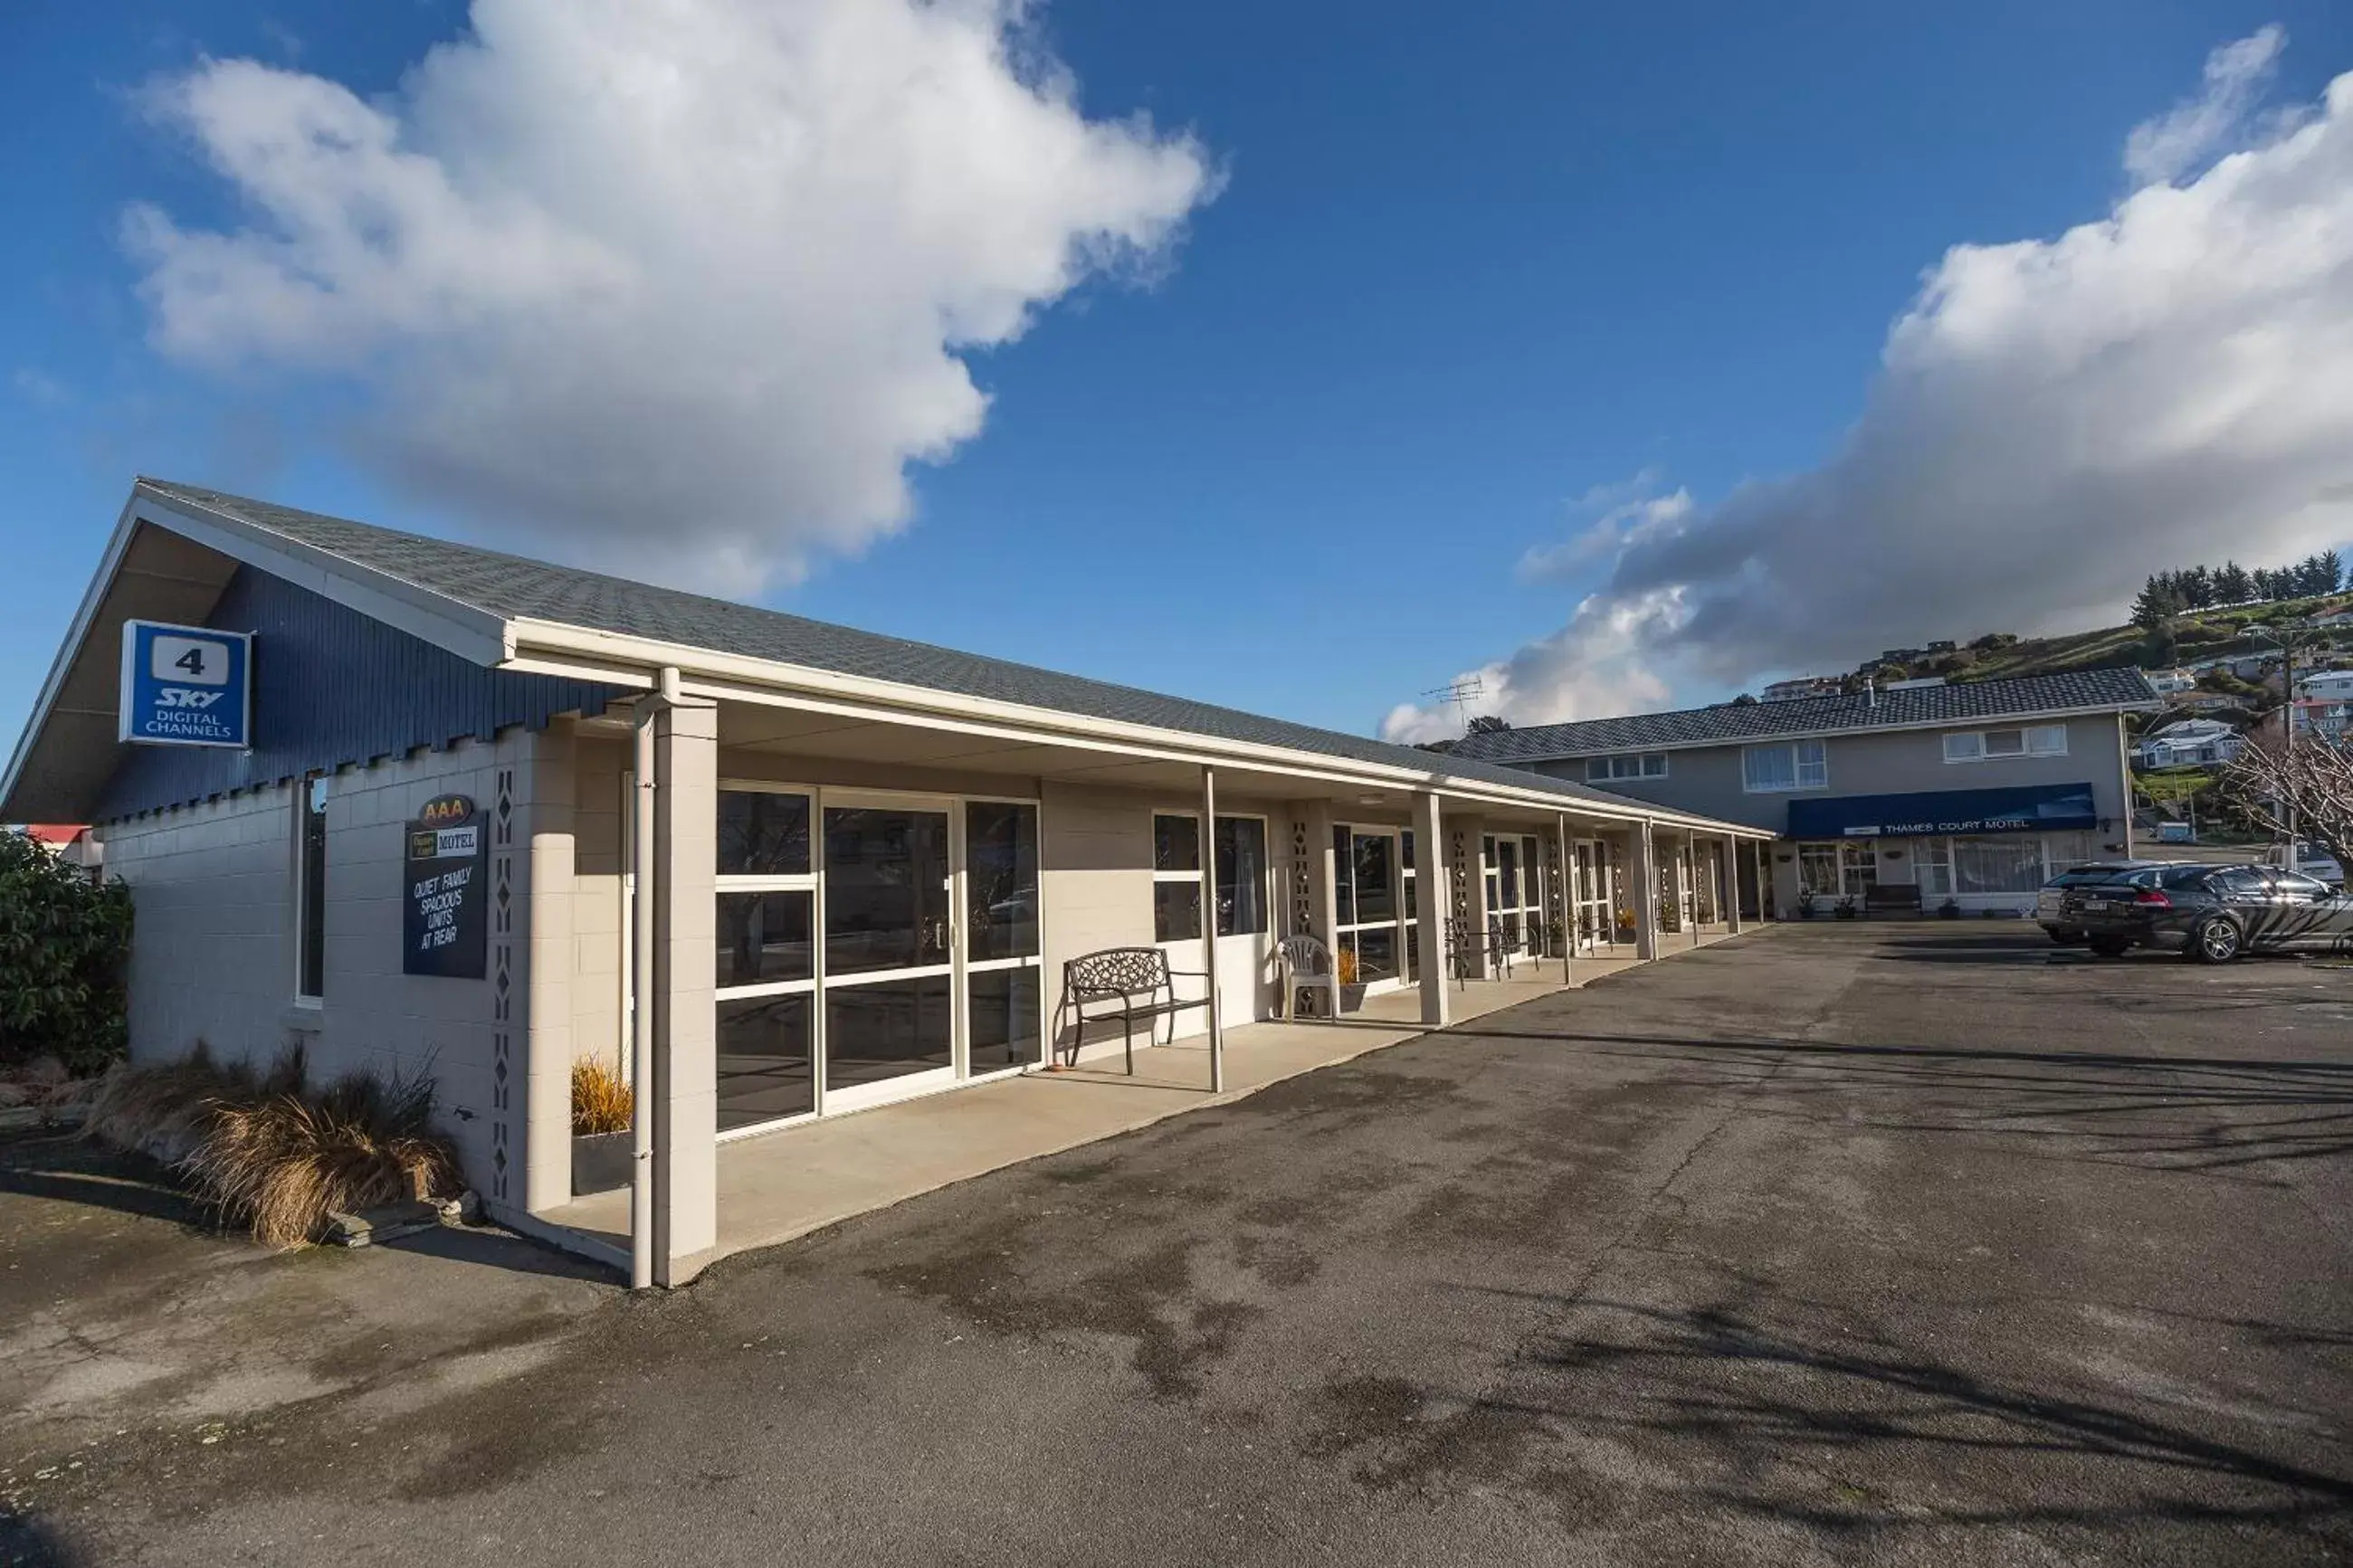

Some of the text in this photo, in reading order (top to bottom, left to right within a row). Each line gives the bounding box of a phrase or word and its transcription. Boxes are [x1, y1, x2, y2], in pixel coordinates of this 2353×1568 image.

[175, 649, 205, 675] 4
[154, 688, 224, 708] SKY
[156, 710, 222, 725] DIGITAL
[145, 721, 232, 737] CHANNELS
[425, 800, 463, 819] AAA
[1886, 820, 2029, 833] THAMES COURT MOTEL
[439, 833, 474, 851] MOTEL
[414, 867, 472, 898] QUIET FAMILY
[421, 890, 462, 915] SPACIOUS
[428, 908, 452, 928] UNITS
[422, 927, 457, 949] AT REAR
